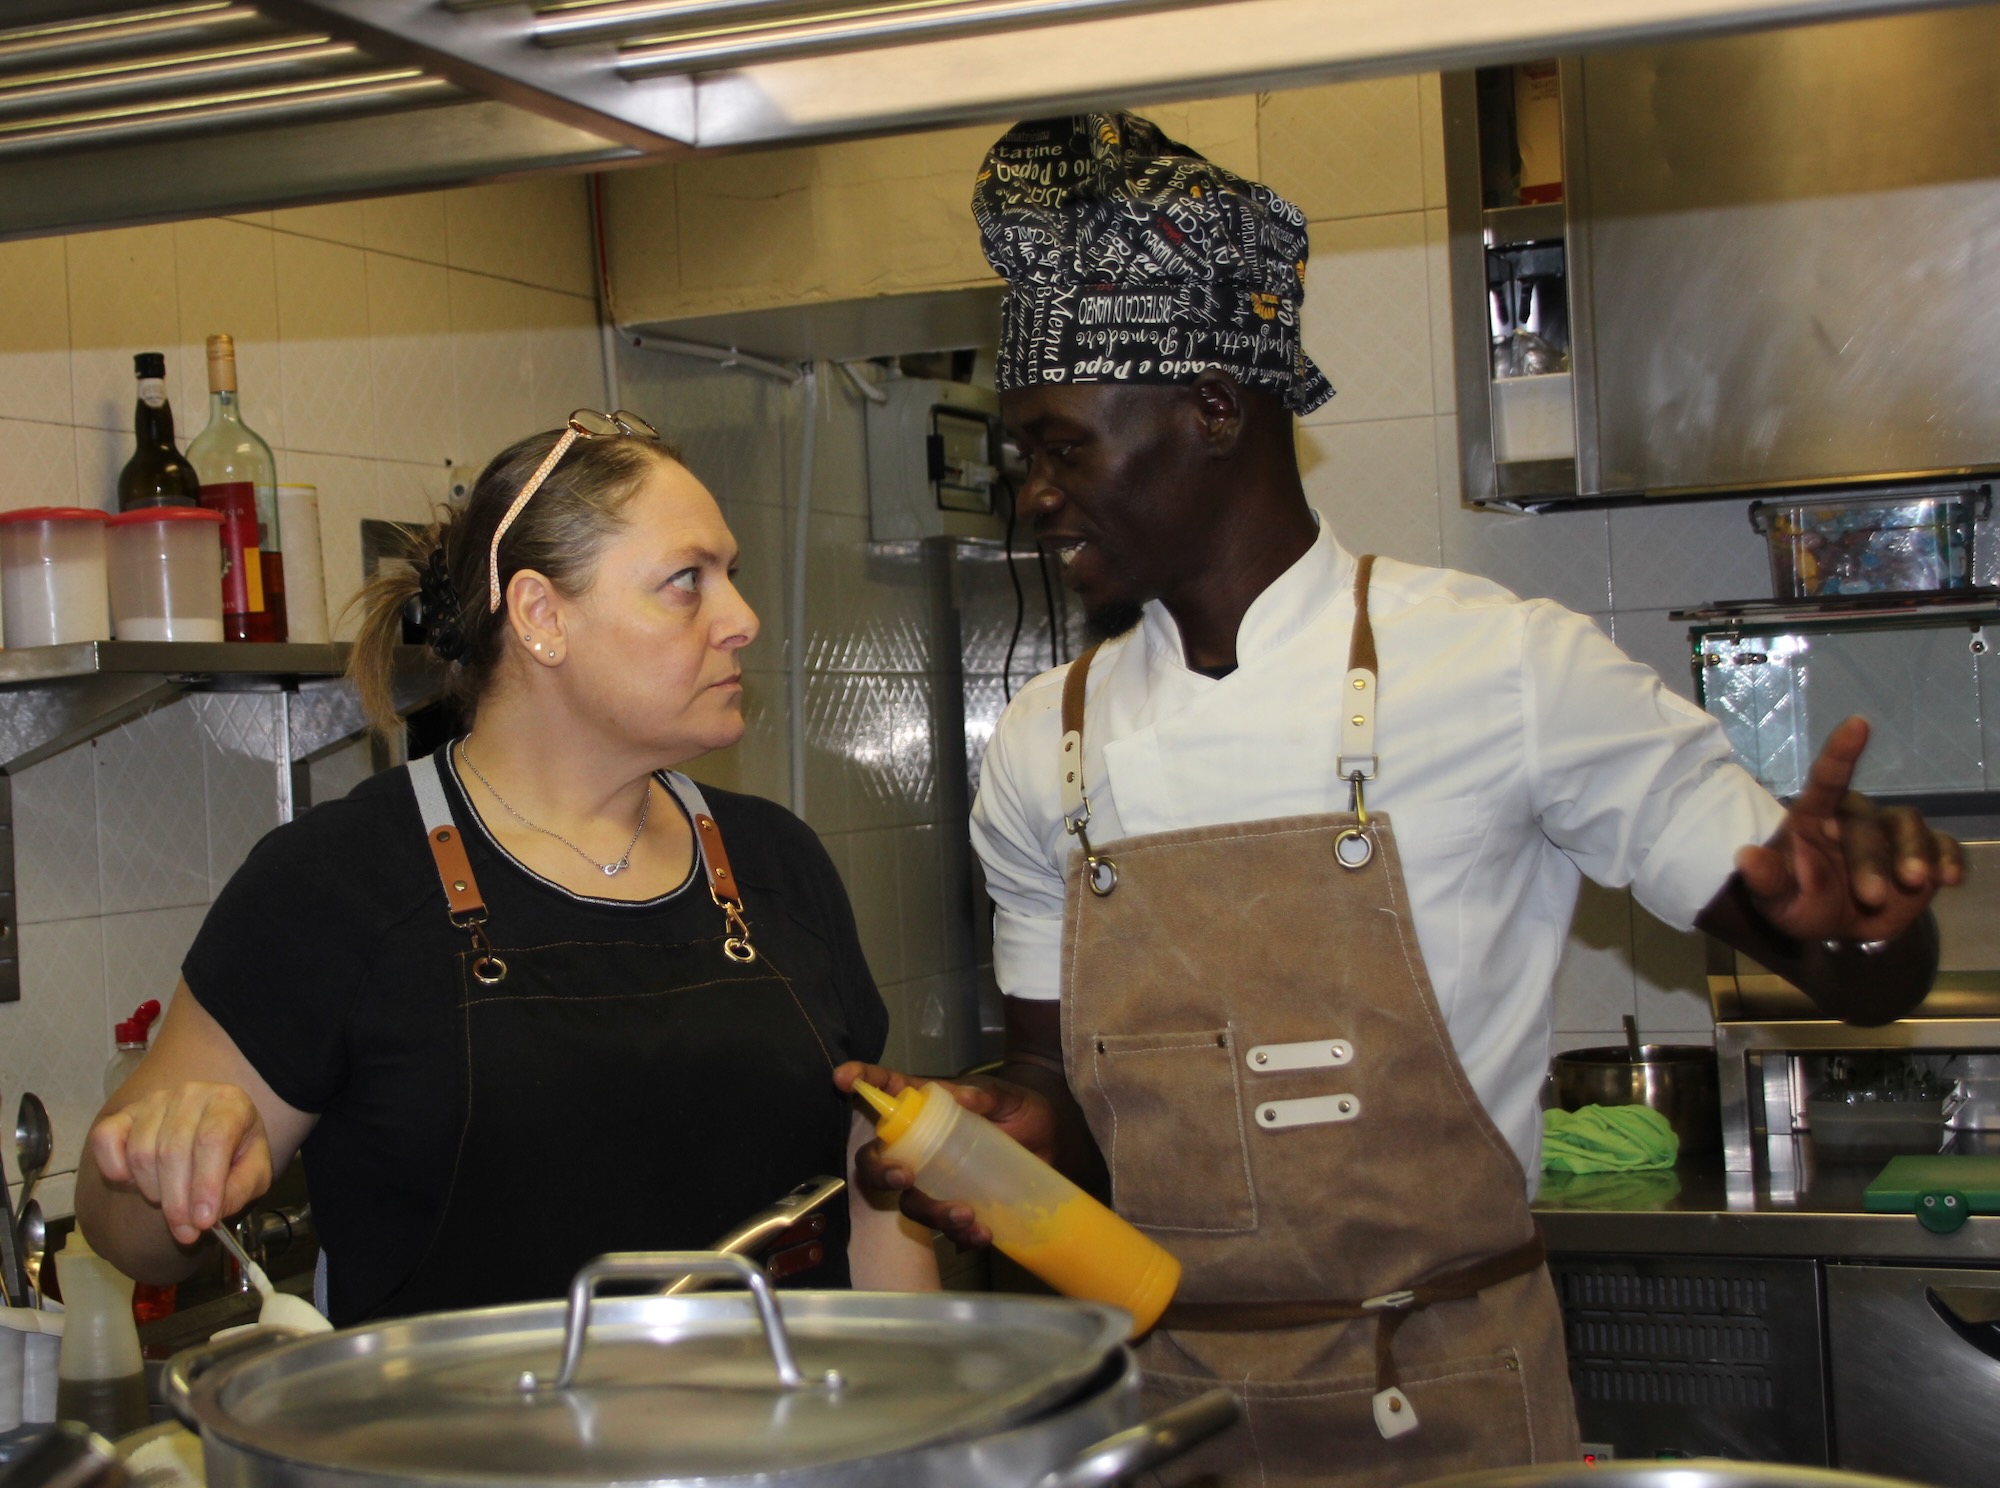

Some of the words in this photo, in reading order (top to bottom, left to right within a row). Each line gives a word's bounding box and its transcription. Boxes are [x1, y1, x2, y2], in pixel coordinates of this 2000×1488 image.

[1043, 284, 1078, 362] Menu
[1112, 295, 1124, 325] DI
[1125, 294, 1173, 326] BISTECCA
[1027, 284, 1054, 385] Bruschetta
[1075, 326, 1179, 358] Pomodoro
[1184, 328, 1208, 360] al
[1211, 323, 1293, 365] Spaghetti
[1073, 356, 1132, 380] Pepe
[1138, 360, 1152, 374] e
